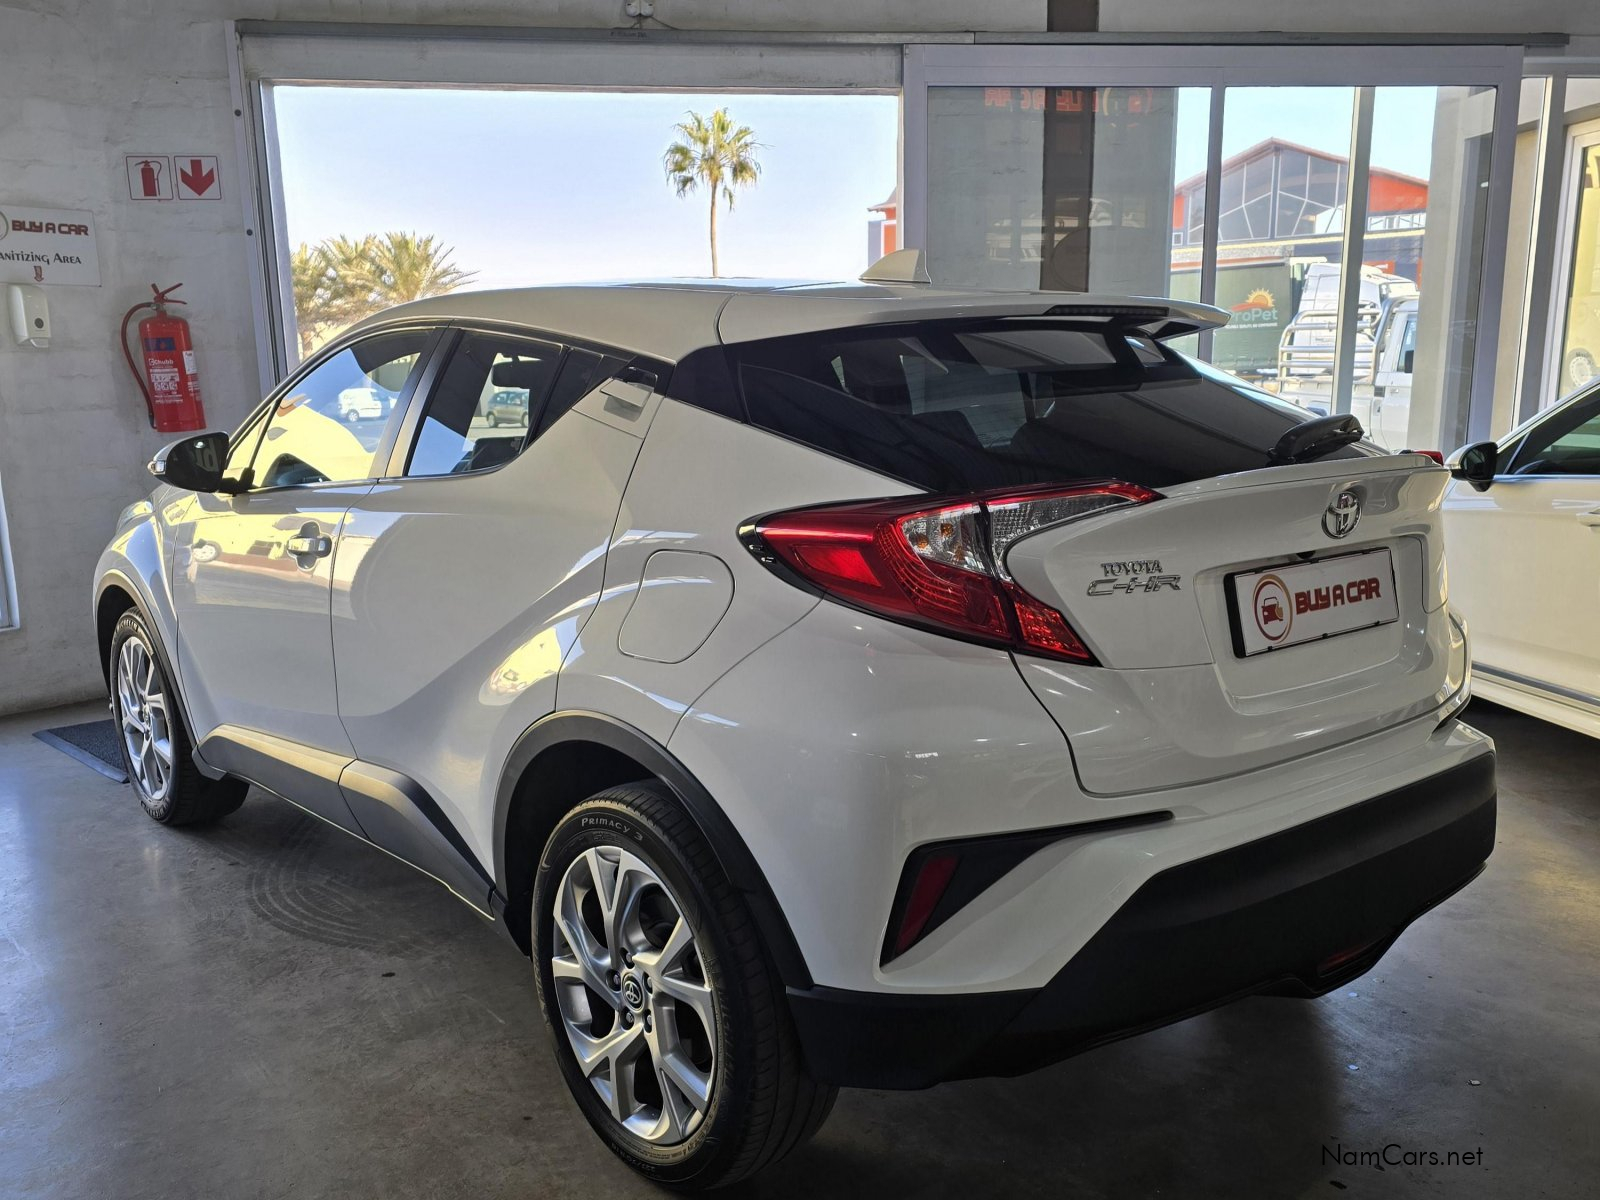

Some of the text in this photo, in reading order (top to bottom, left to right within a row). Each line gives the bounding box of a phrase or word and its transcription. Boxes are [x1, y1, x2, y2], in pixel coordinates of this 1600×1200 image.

[11, 219, 89, 236] BUY A CAR
[1101, 560, 1163, 577] TOYOTA
[1087, 575, 1182, 597] C-HR
[1294, 577, 1381, 615] BUY A CAR
[634, 831, 643, 841] 3
